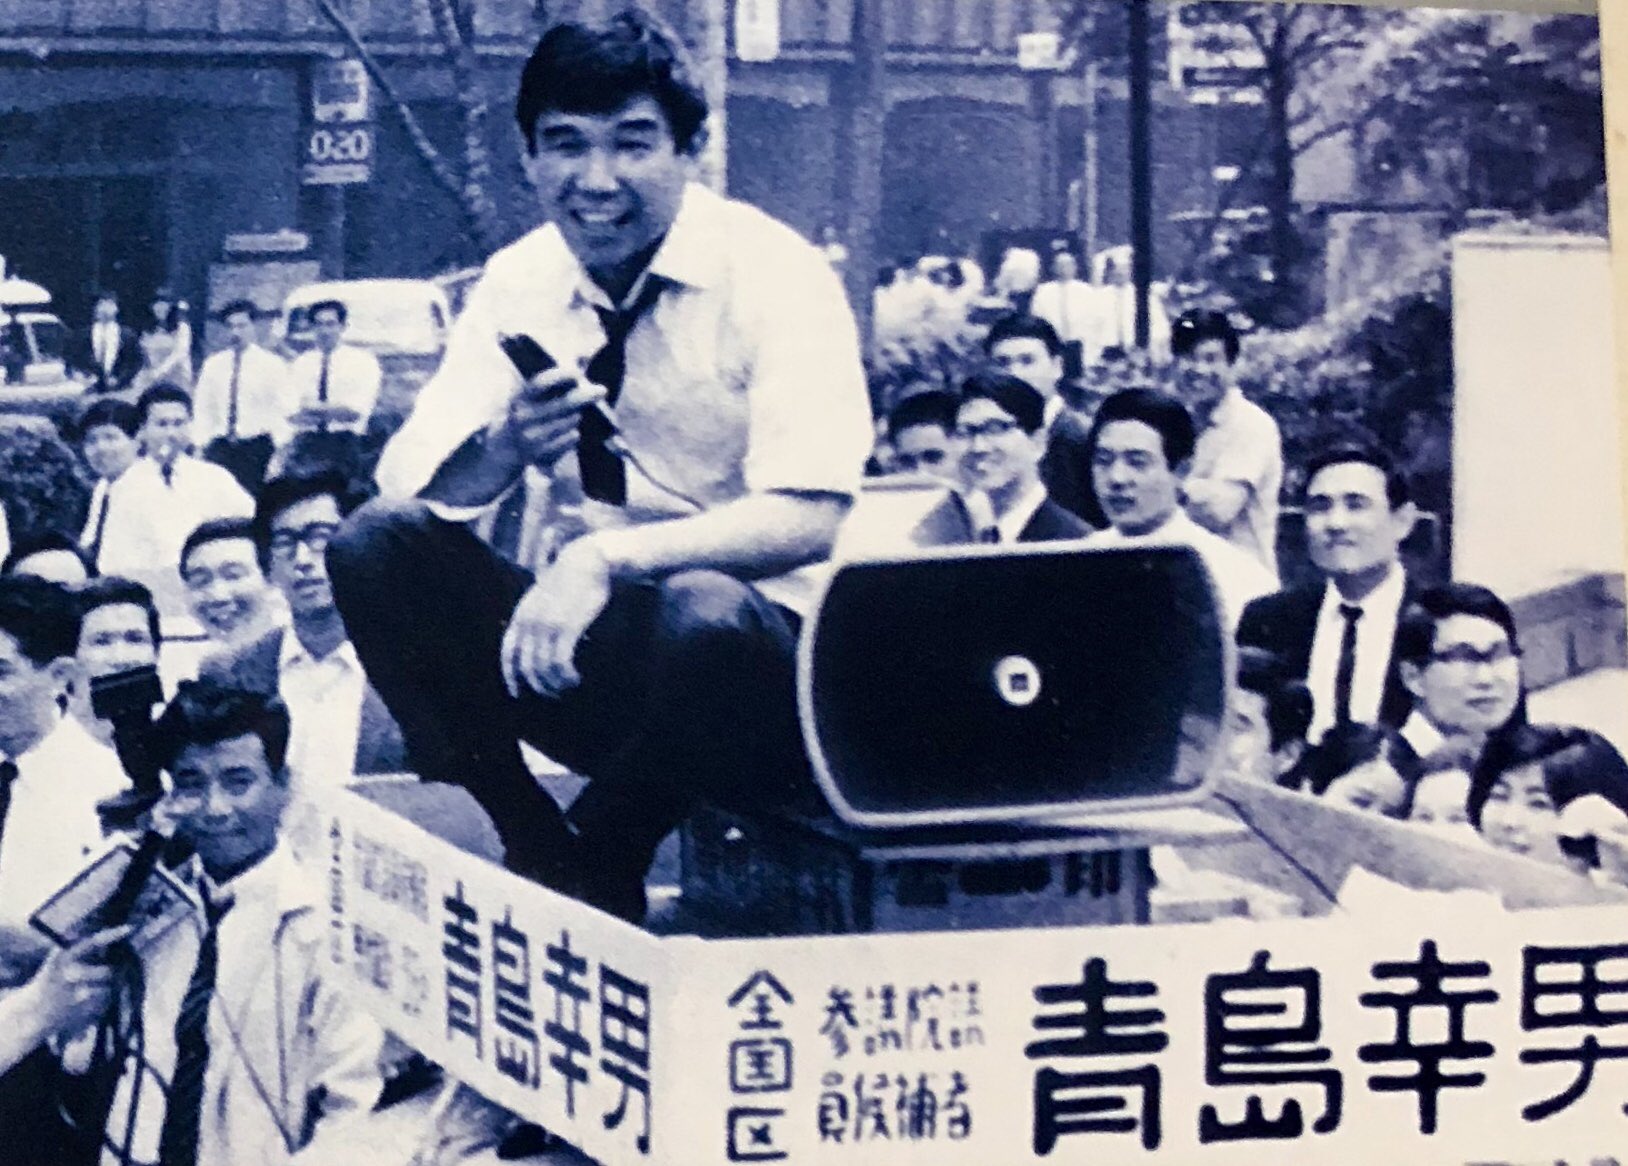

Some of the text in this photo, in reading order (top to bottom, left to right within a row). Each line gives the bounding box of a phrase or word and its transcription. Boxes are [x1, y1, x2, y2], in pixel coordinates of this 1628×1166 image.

[442, 880, 651, 1154] 青島幸男
[726, 968, 796, 1162] 全国区
[1023, 938, 1628, 1157] 青島幸男
